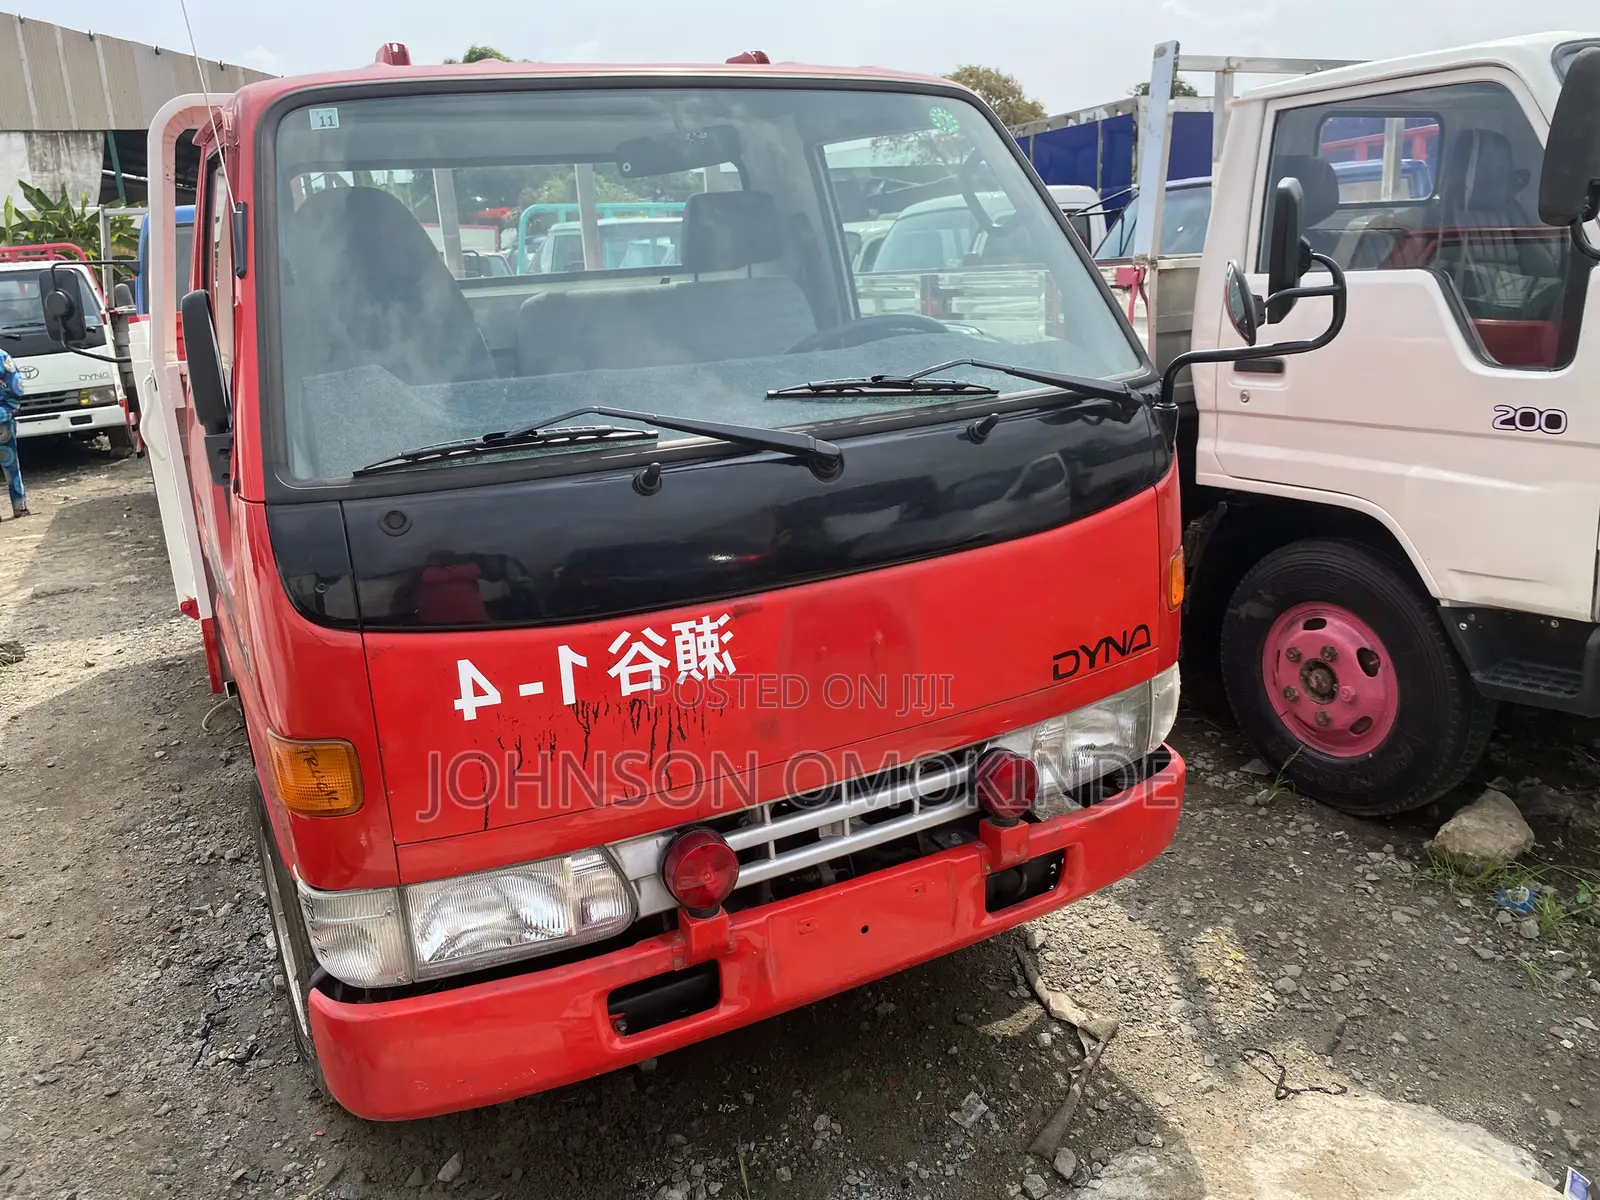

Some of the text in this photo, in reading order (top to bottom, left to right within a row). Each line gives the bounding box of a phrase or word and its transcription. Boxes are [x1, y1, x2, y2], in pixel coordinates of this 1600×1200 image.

[319, 115, 335, 127] 11
[79, 372, 109, 380] DYNA
[1492, 404, 1568, 435] 200
[1053, 624, 1151, 680] DYNA
